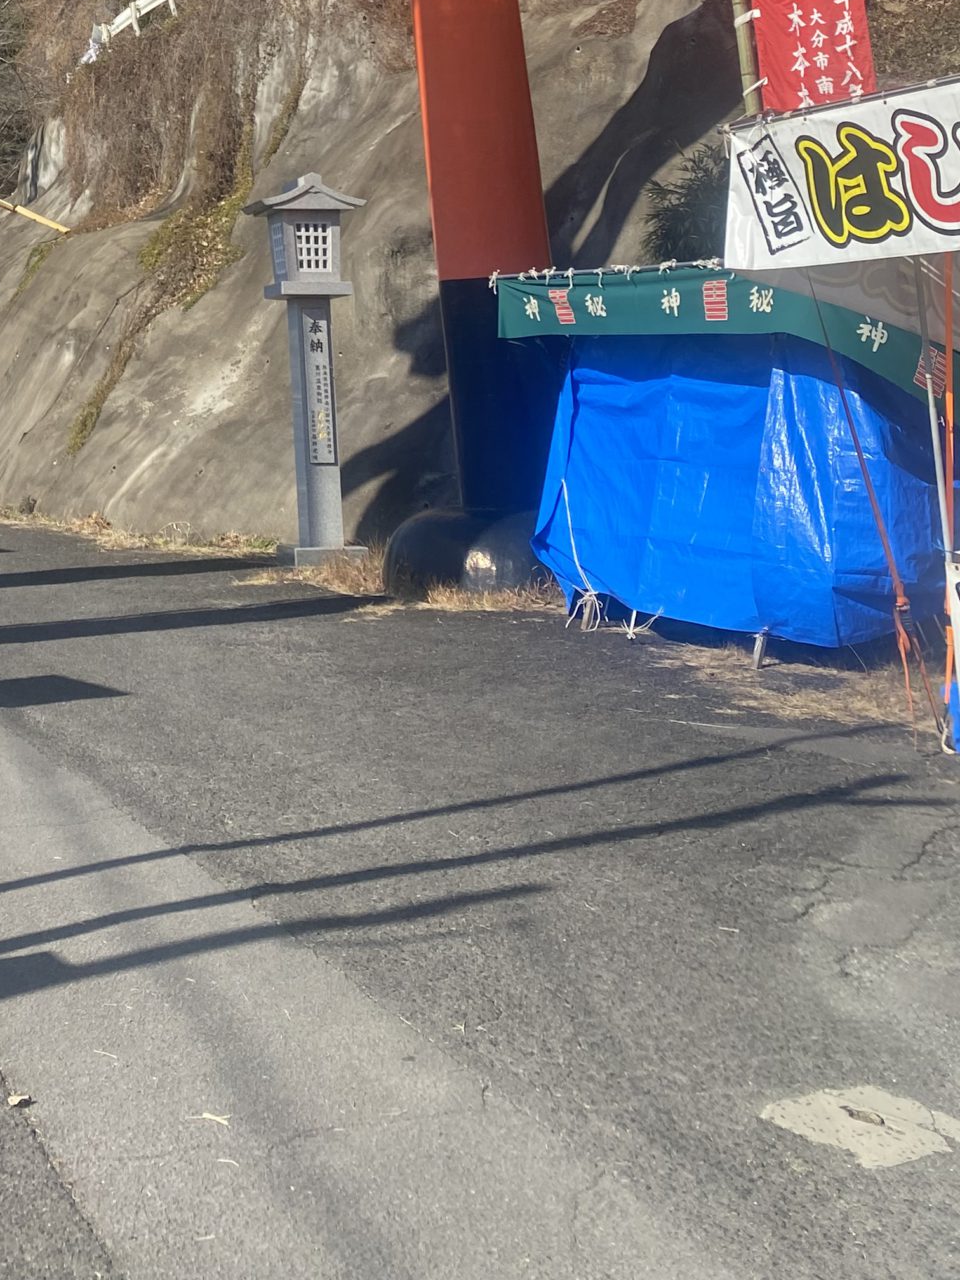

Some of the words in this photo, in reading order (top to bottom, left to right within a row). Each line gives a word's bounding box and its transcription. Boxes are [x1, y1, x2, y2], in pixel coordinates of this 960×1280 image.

[809, 7, 835, 103] 大分市南
[795, 108, 960, 250] はし
[308, 320, 324, 354] 奉納
[522, 295, 541, 322] 神
[584, 293, 607, 317] 秘
[660, 287, 681, 317] 神
[748, 285, 774, 313] 秘
[856, 316, 888, 352] 神
